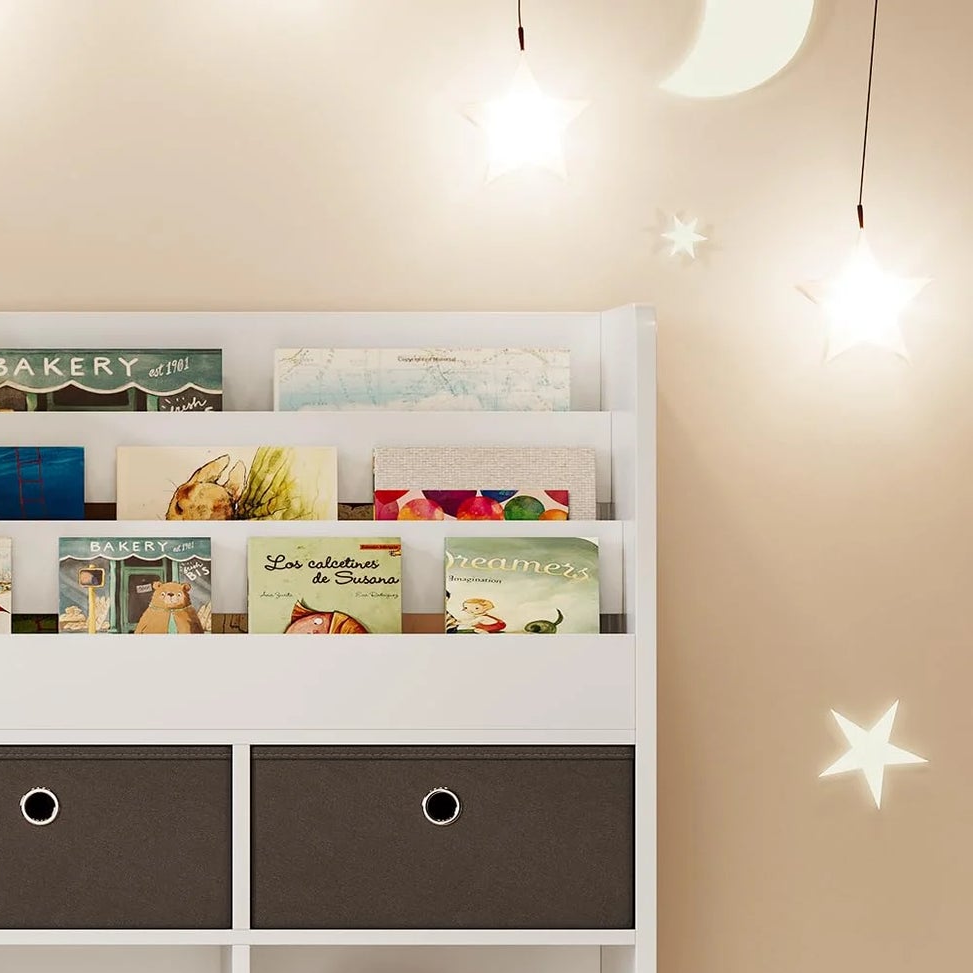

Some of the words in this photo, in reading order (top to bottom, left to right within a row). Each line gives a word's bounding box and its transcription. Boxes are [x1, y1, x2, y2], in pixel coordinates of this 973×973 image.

[90, 541, 169, 552] BAKERY
[264, 554, 304, 570] Los
[307, 553, 380, 570] calcetines
[186, 566, 210, 581] BIS
[312, 571, 329, 585] de
[335, 570, 400, 585] Susana
[447, 574, 503, 584] Imagination
